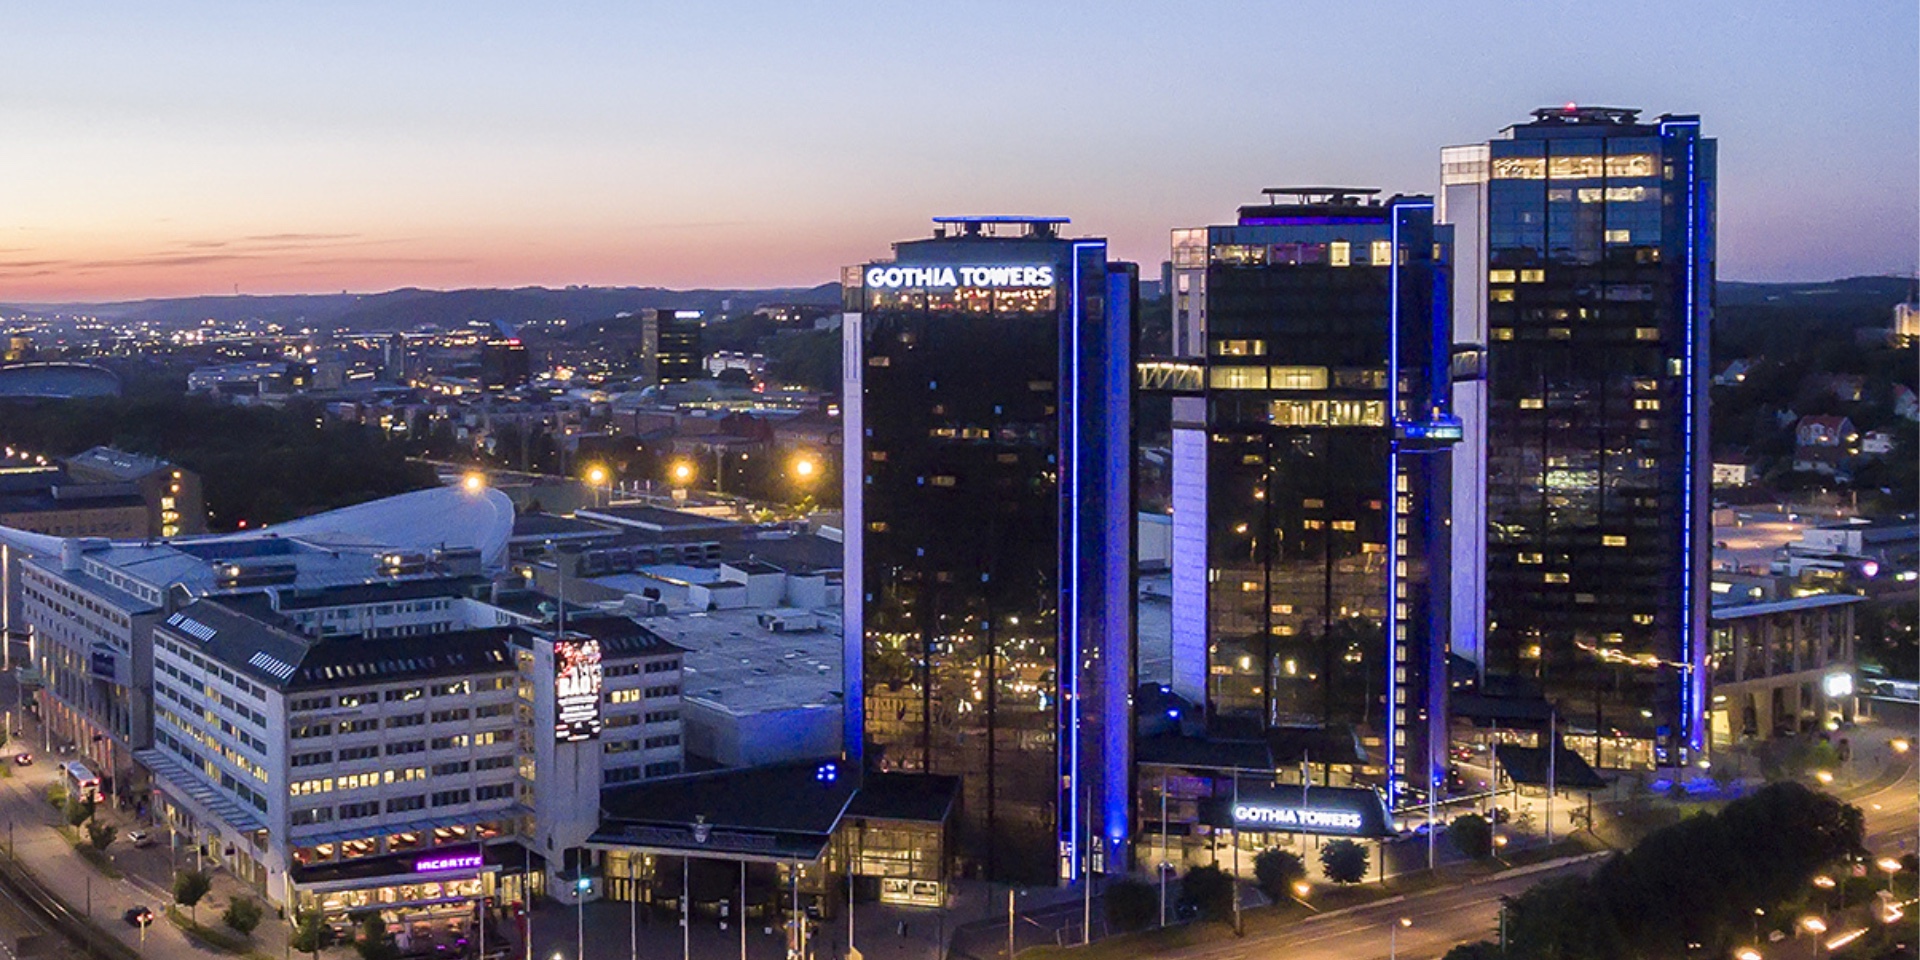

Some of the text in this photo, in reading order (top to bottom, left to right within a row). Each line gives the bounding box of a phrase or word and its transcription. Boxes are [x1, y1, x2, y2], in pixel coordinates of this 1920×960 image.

[866, 266, 1053, 287] GOTHIA TOWERS
[1235, 807, 1361, 828] GOTHIA TOWERS
